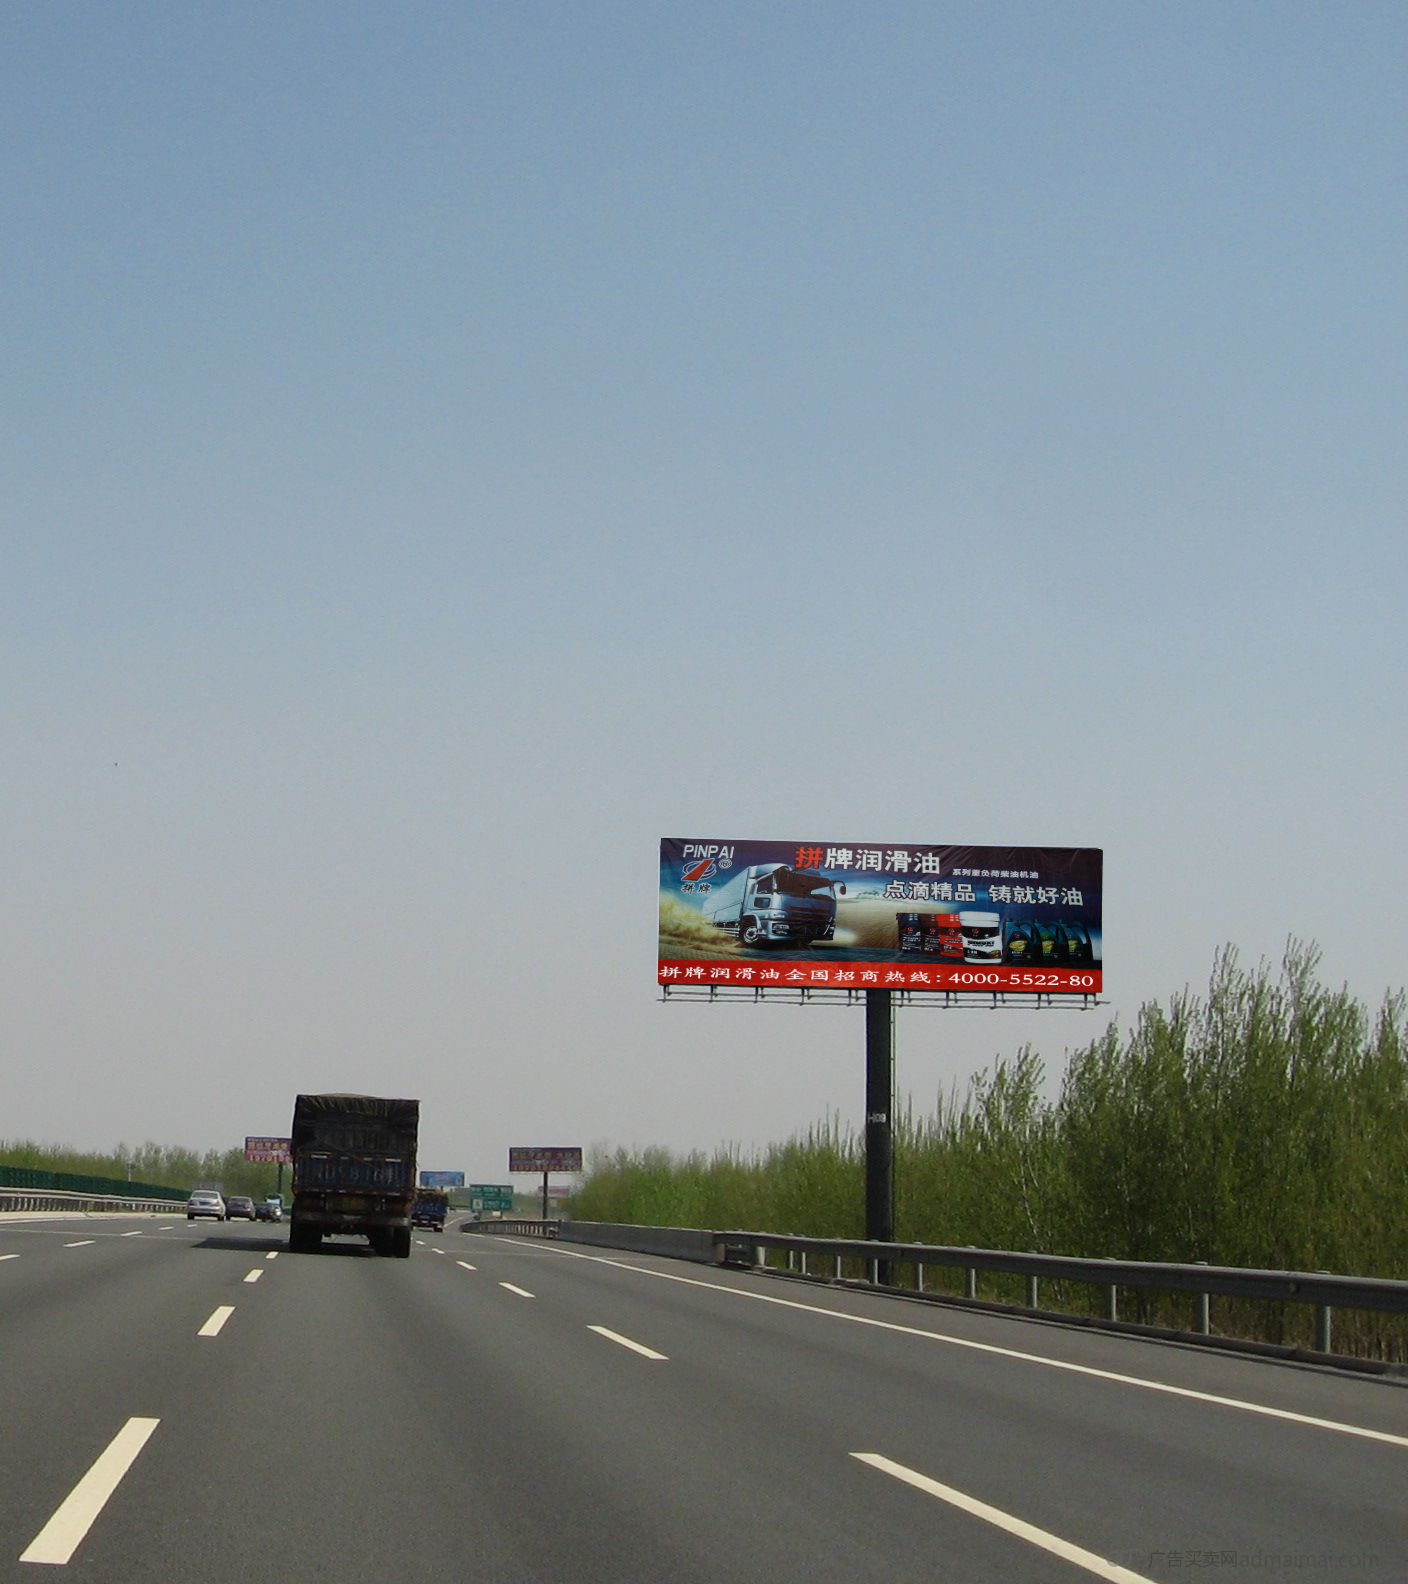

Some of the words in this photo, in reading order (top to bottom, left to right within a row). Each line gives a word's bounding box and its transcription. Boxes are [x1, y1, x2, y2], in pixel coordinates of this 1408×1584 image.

[682, 844, 735, 859] PINPAI
[794, 846, 940, 875] 拼牌润滑油
[952, 868, 1039, 880] 系列重负荷柴油机油
[681, 882, 712, 895] 拼牌
[884, 879, 977, 902] 点滴精品
[988, 884, 1084, 906] 铸就好油
